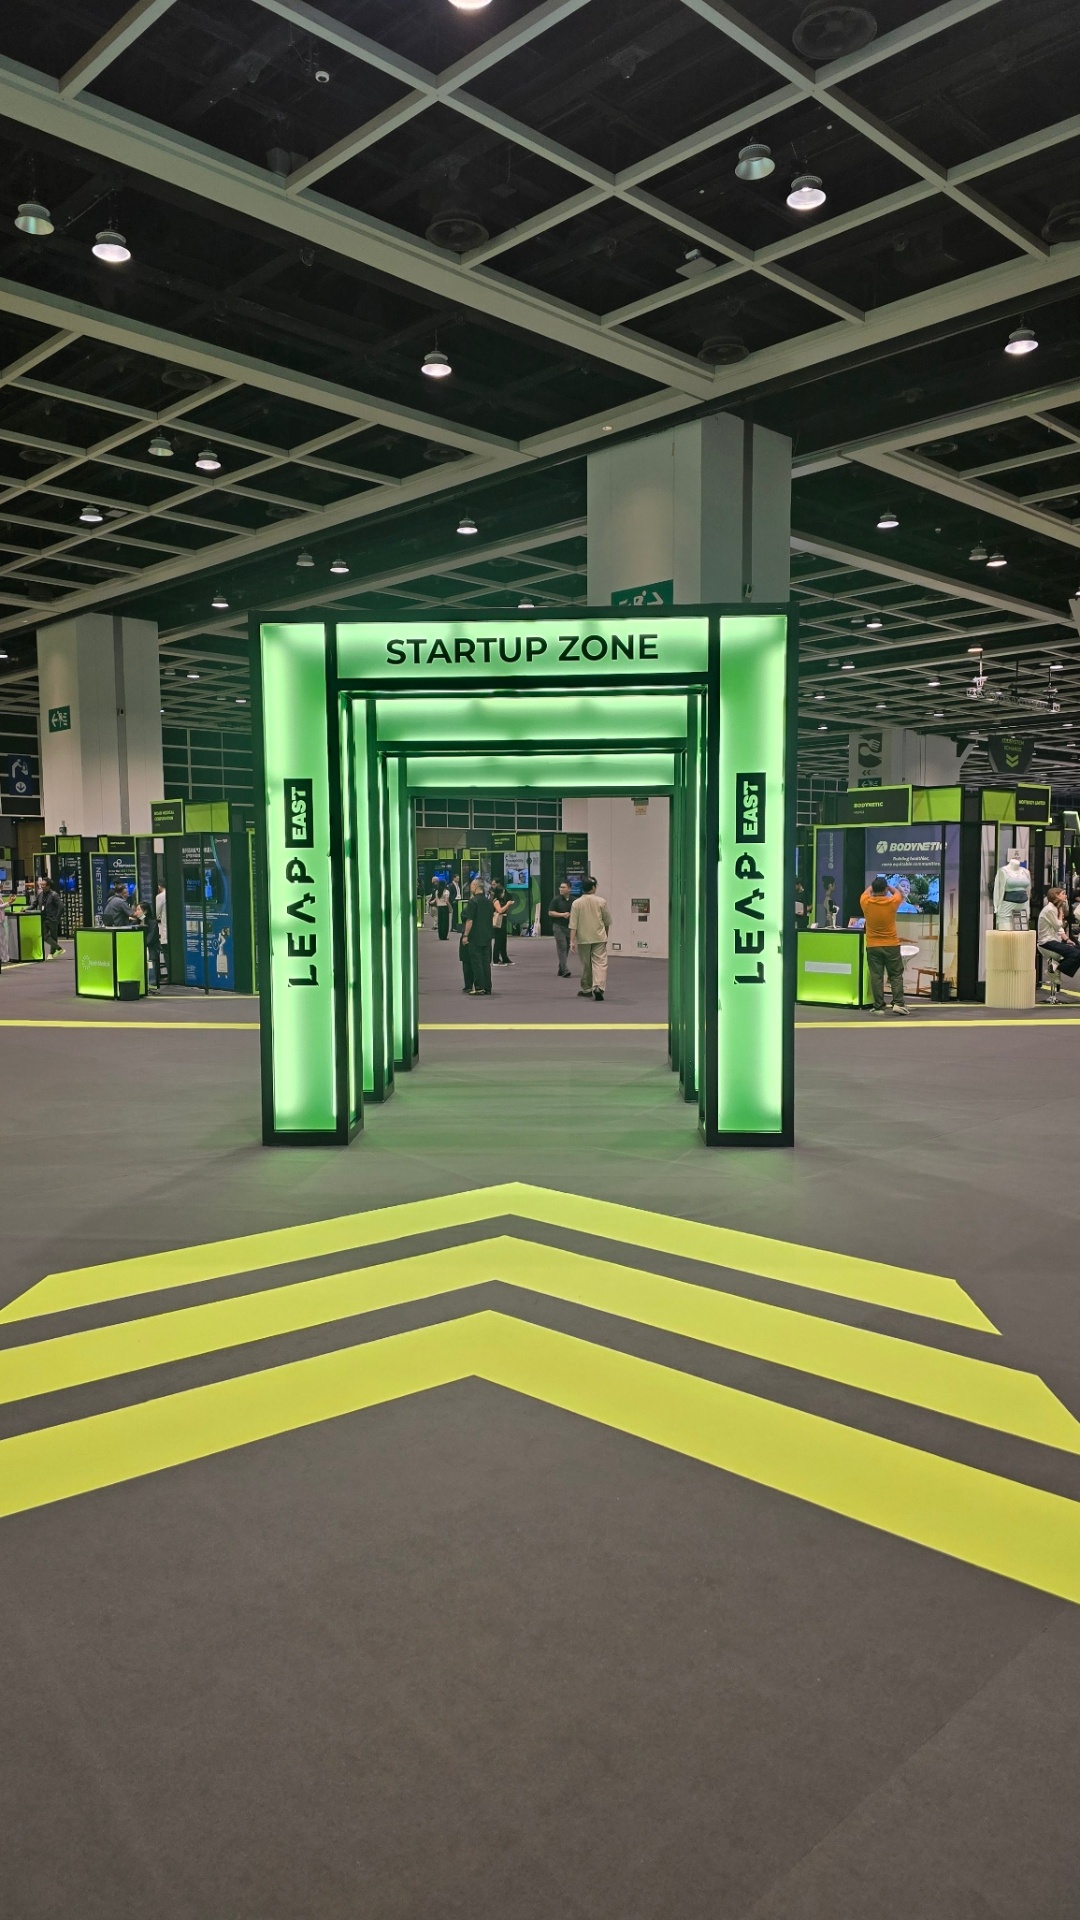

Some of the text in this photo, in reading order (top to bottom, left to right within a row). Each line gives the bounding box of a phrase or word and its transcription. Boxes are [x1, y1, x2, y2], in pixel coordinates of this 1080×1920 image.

[386, 633, 659, 665] STARTUP ZONE
[286, 786, 319, 988] LEAP EAST
[733, 781, 766, 984] LEAP EAST
